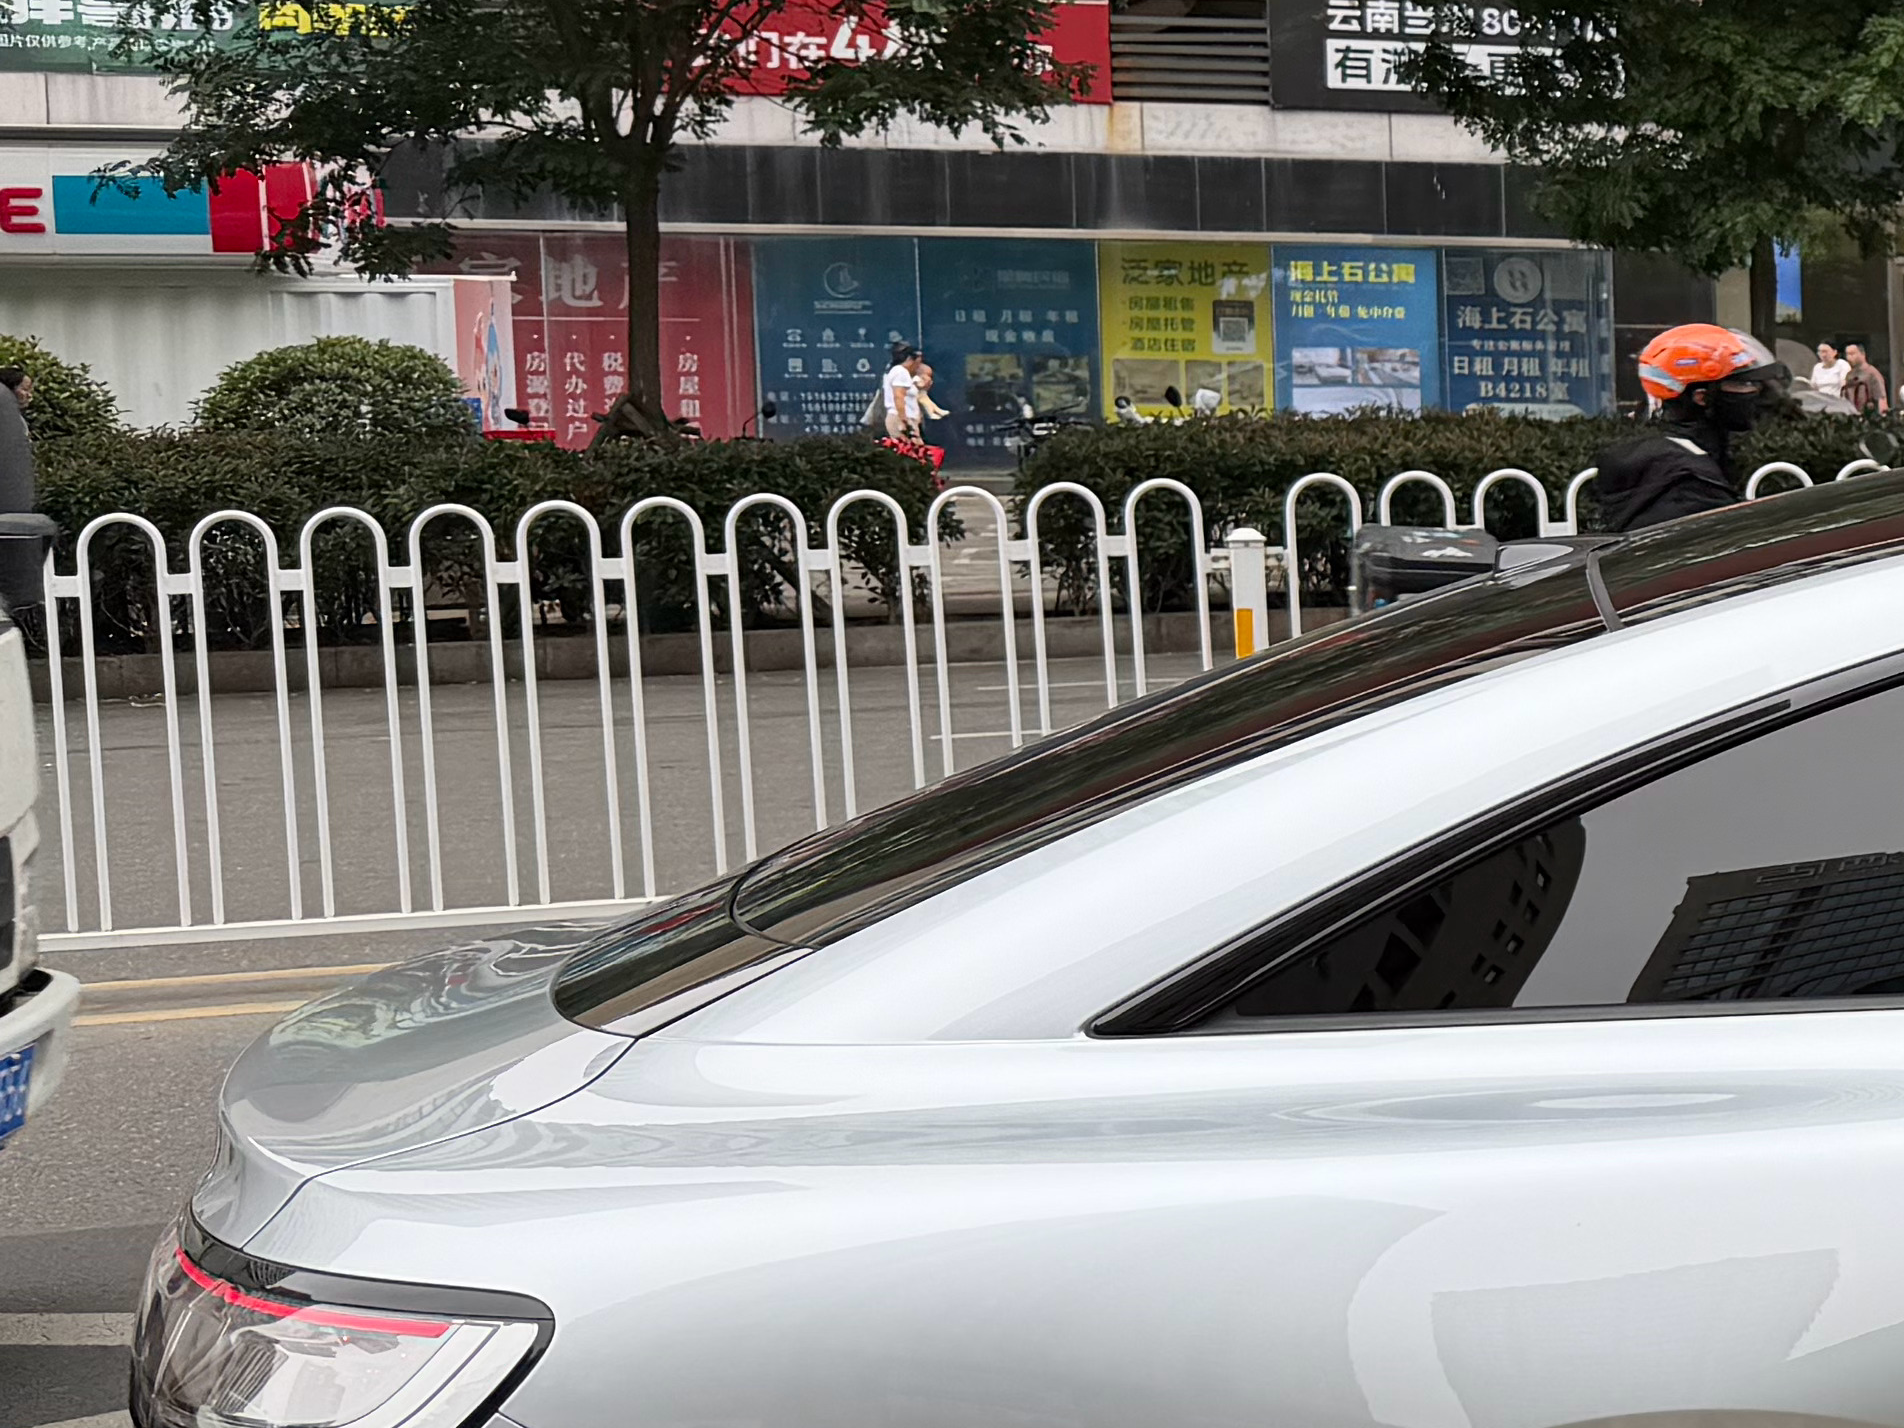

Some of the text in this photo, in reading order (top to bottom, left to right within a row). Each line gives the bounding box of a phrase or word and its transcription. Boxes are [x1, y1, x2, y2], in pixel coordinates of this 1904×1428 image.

[1457, 305, 1587, 334] 海上石公寓
[1454, 356, 1495, 376] 日租
[1502, 356, 1541, 377] 月租
[563, 351, 589, 441] 代办过户
